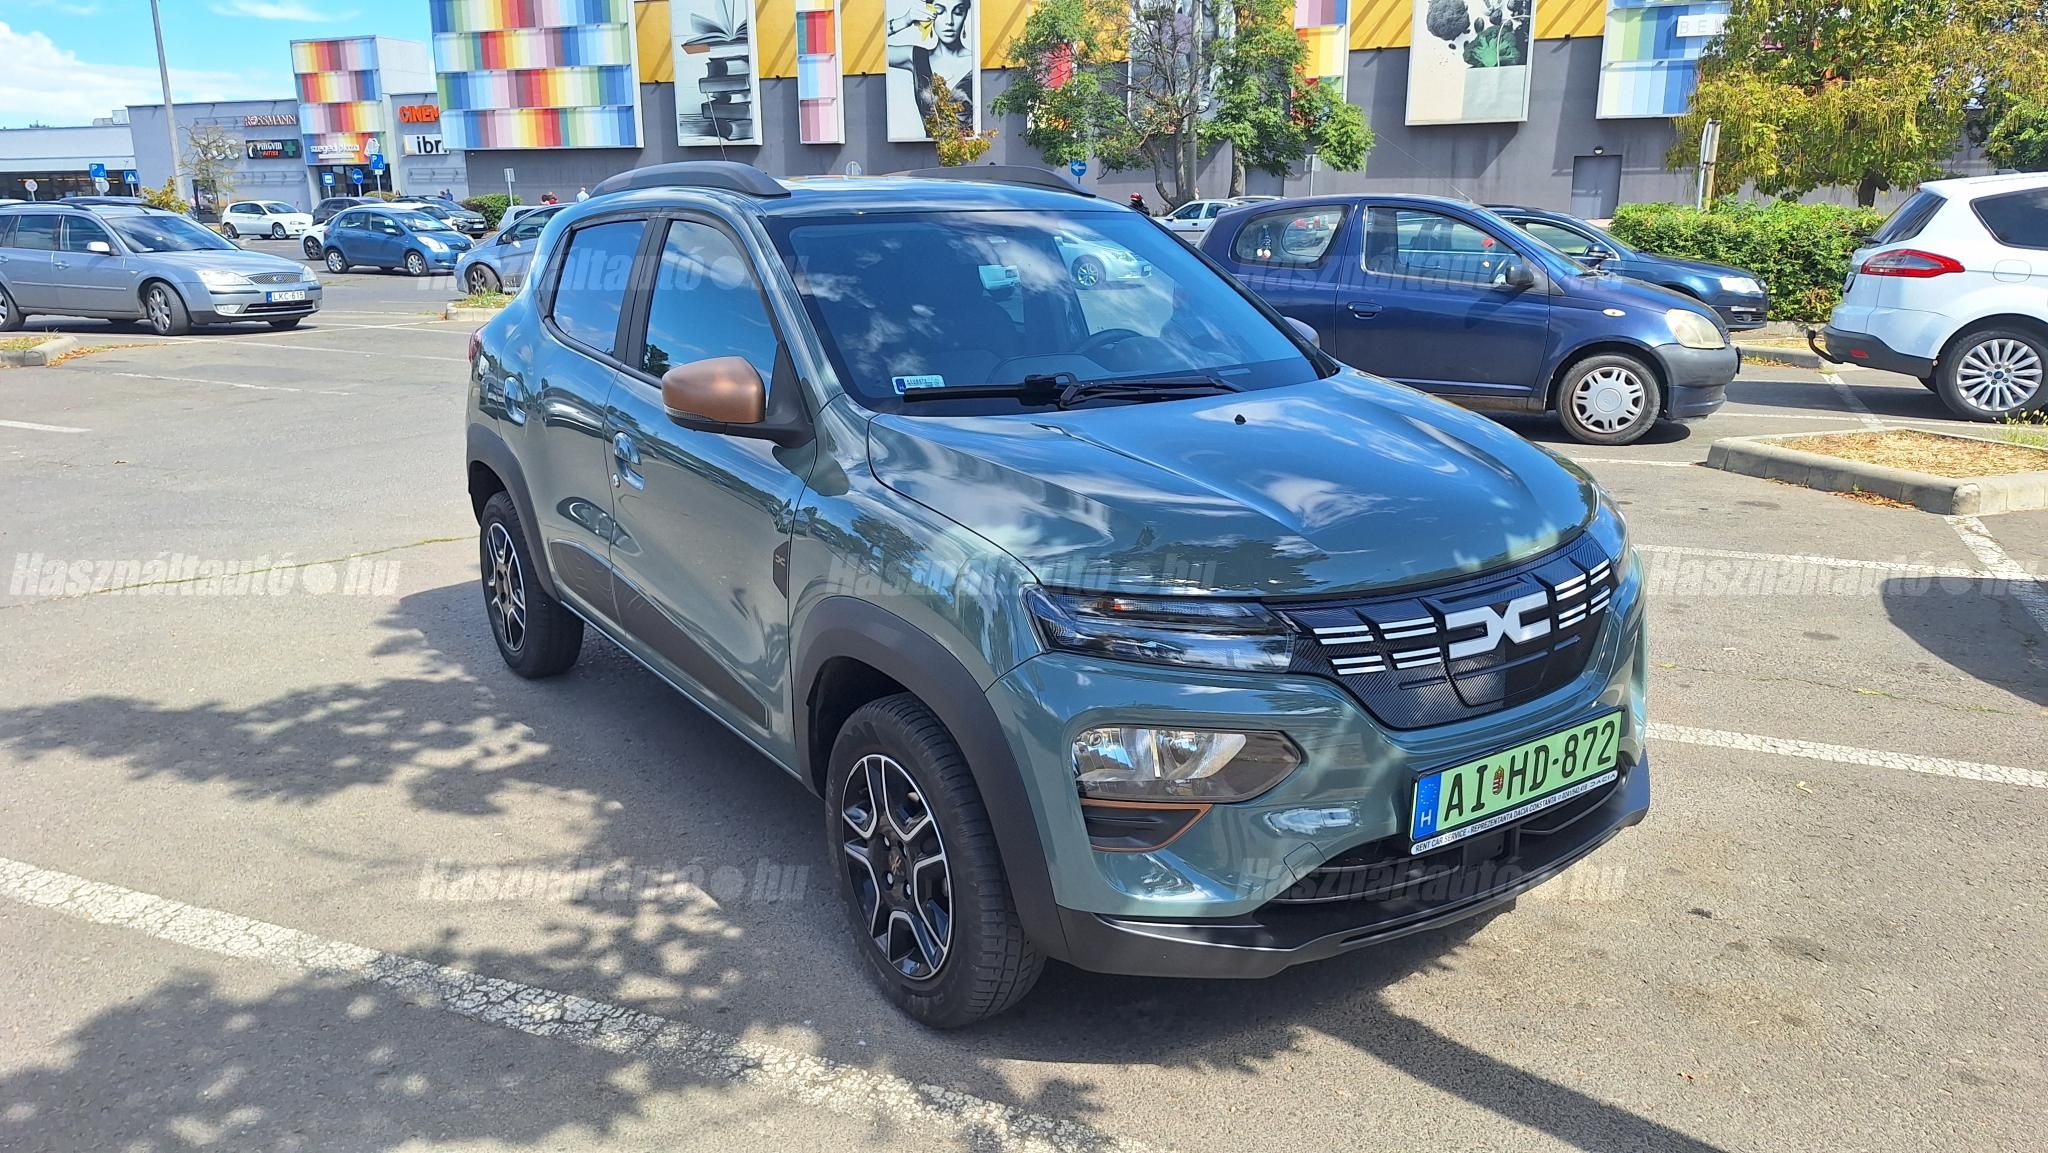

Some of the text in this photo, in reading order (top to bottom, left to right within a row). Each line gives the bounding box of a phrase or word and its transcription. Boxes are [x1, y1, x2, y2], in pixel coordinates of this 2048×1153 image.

[244, 114, 297, 126] ROSSMANN
[416, 136, 447, 154] ibr
[1415, 842, 1431, 852] RENT
[1431, 838, 1444, 847] CAR
[1444, 829, 1467, 843] SERVICE
[1513, 806, 1529, 818] DACIA
[1590, 773, 1616, 787] DACIA
[1420, 809, 1432, 828] H
